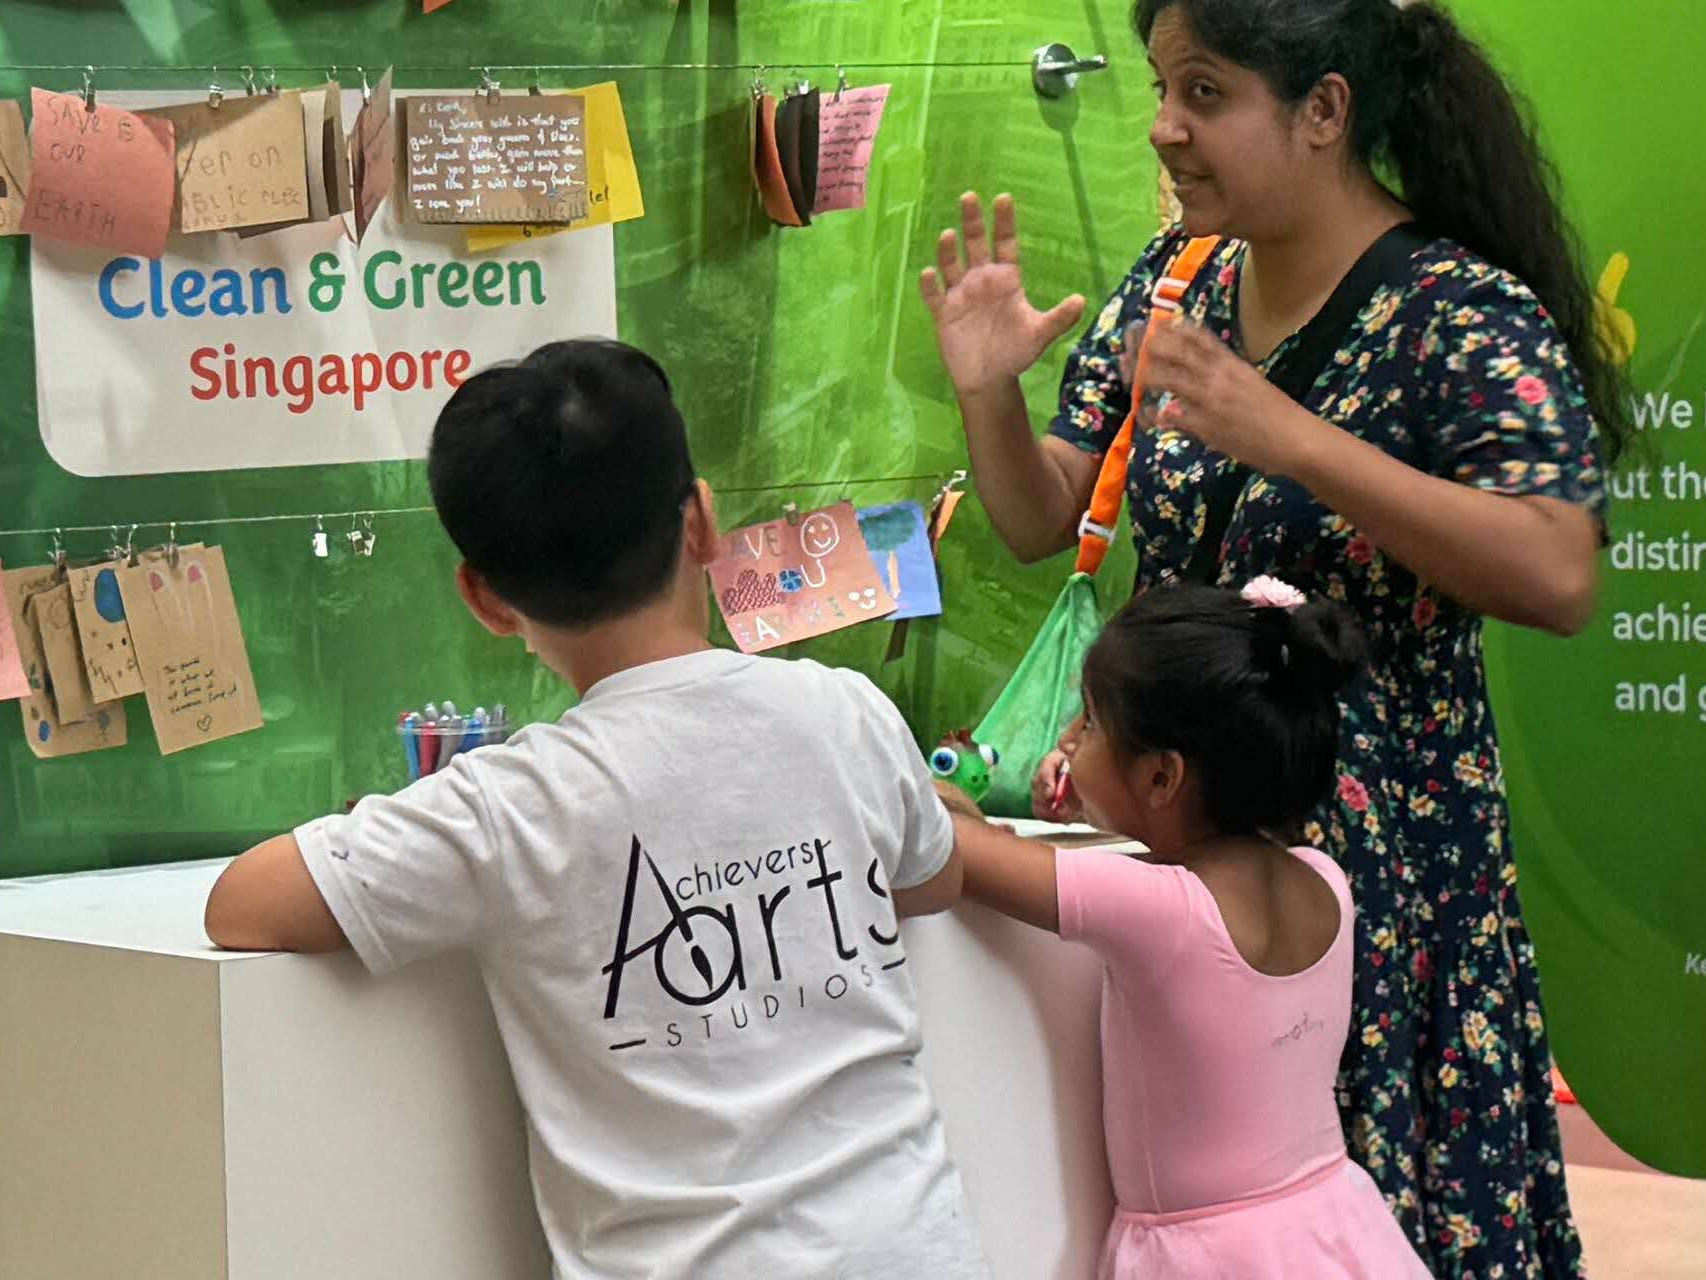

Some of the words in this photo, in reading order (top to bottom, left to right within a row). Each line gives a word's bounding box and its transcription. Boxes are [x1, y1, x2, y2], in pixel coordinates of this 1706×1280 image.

[98, 256, 292, 319] Clean
[308, 251, 345, 312] &
[363, 250, 546, 309] Green
[190, 344, 471, 413] Singapore
[1630, 392, 1692, 428] We
[1603, 466, 1651, 501] ut
[1615, 674, 1685, 712] and
[667, 965, 875, 1047] STUDIOS
